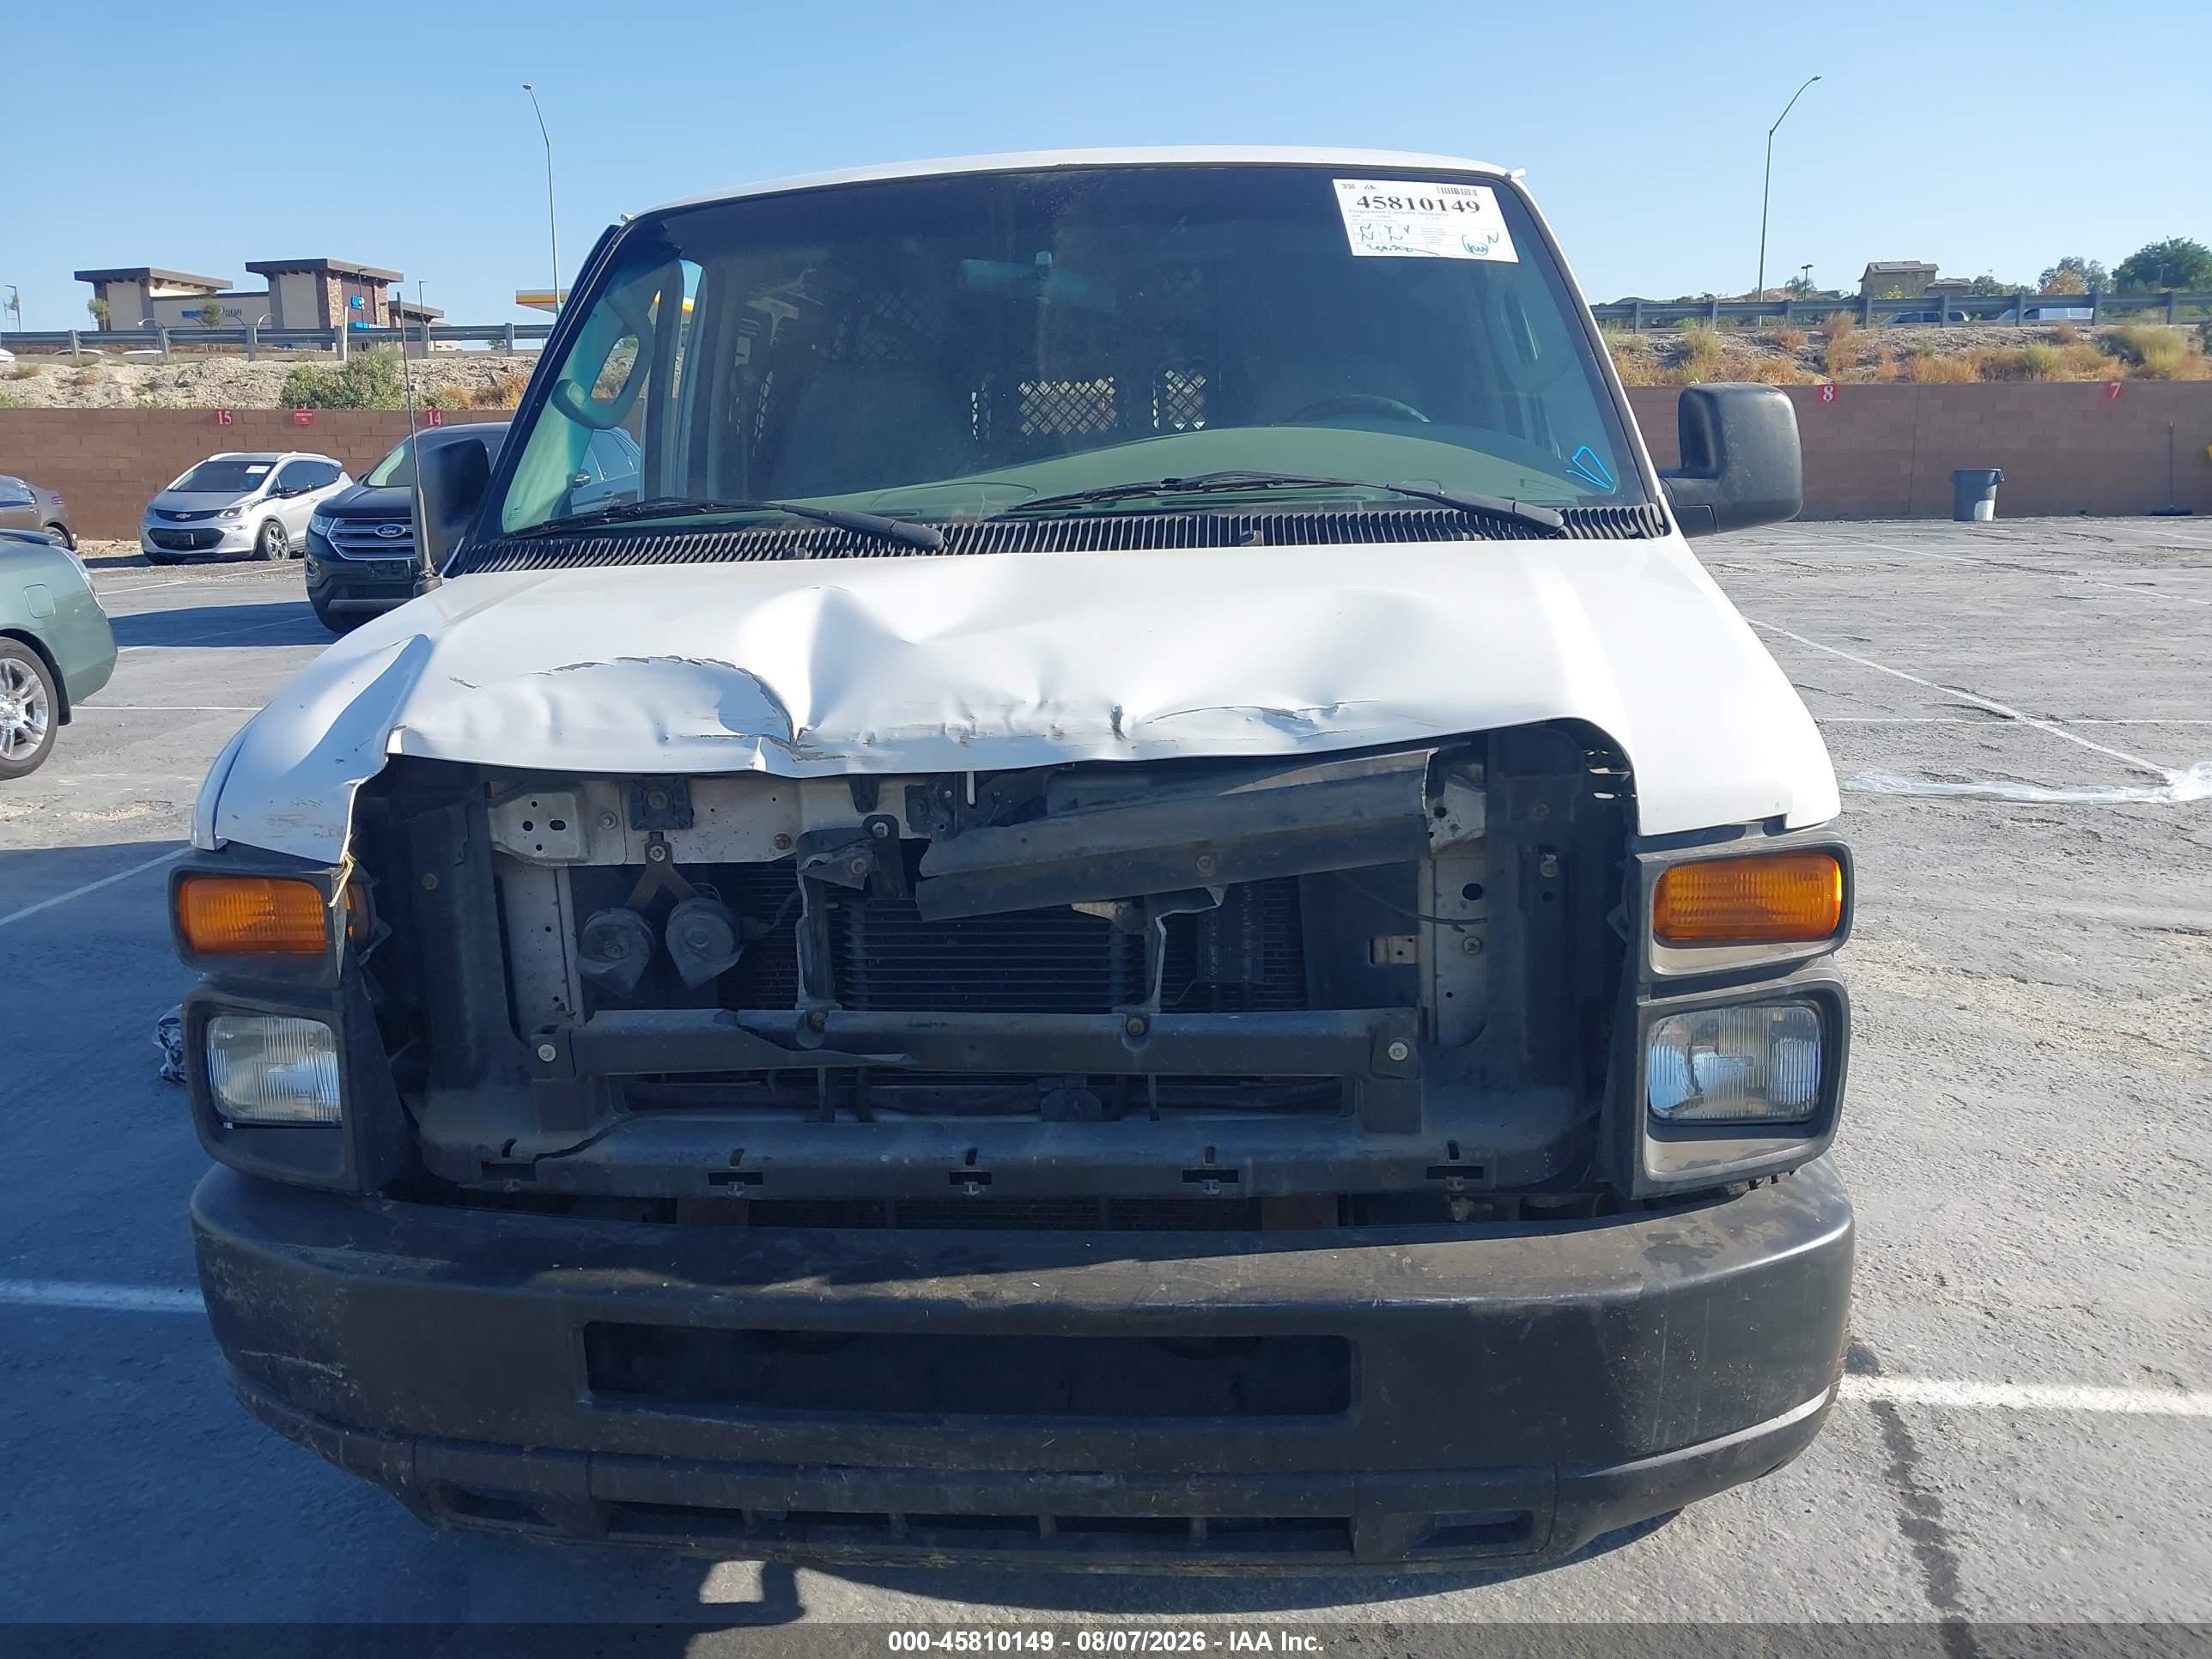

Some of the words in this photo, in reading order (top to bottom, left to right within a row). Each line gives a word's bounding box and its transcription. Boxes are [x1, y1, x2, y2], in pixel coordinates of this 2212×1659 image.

[1356, 195, 1480, 214] 45810149
[1822, 385, 1834, 401] 8
[2110, 381, 2123, 399] 7
[216, 410, 233, 425] 15
[428, 410, 442, 426] 14
